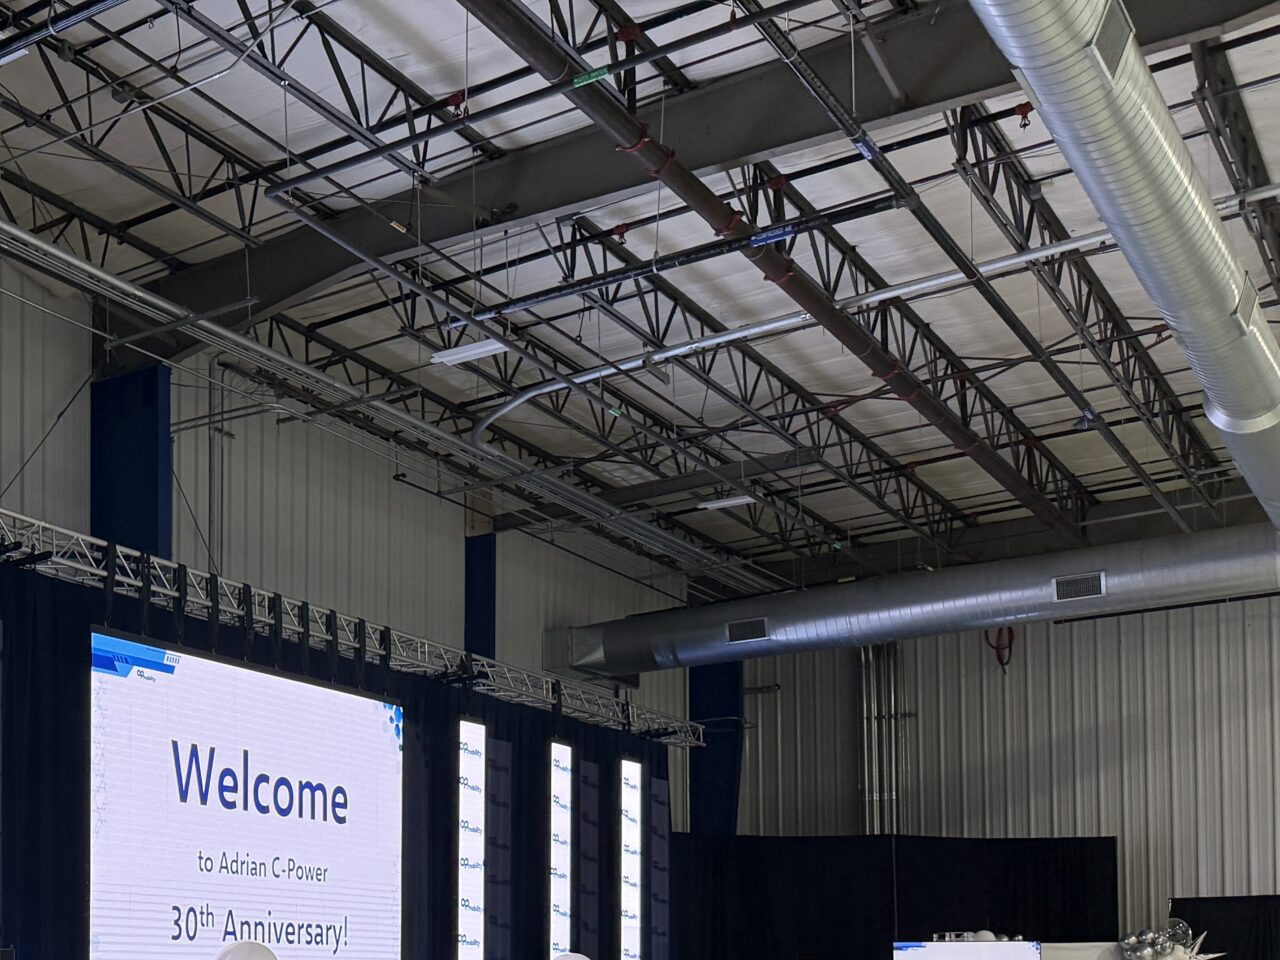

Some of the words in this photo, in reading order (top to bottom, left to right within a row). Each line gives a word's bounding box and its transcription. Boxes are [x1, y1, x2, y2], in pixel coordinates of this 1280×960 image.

[171, 739, 348, 825] Welcome
[198, 850, 214, 872] to
[219, 851, 267, 878] Adrian
[271, 856, 328, 883] C-Power
[171, 903, 215, 942] 30th
[222, 909, 348, 955] Anniversary!
